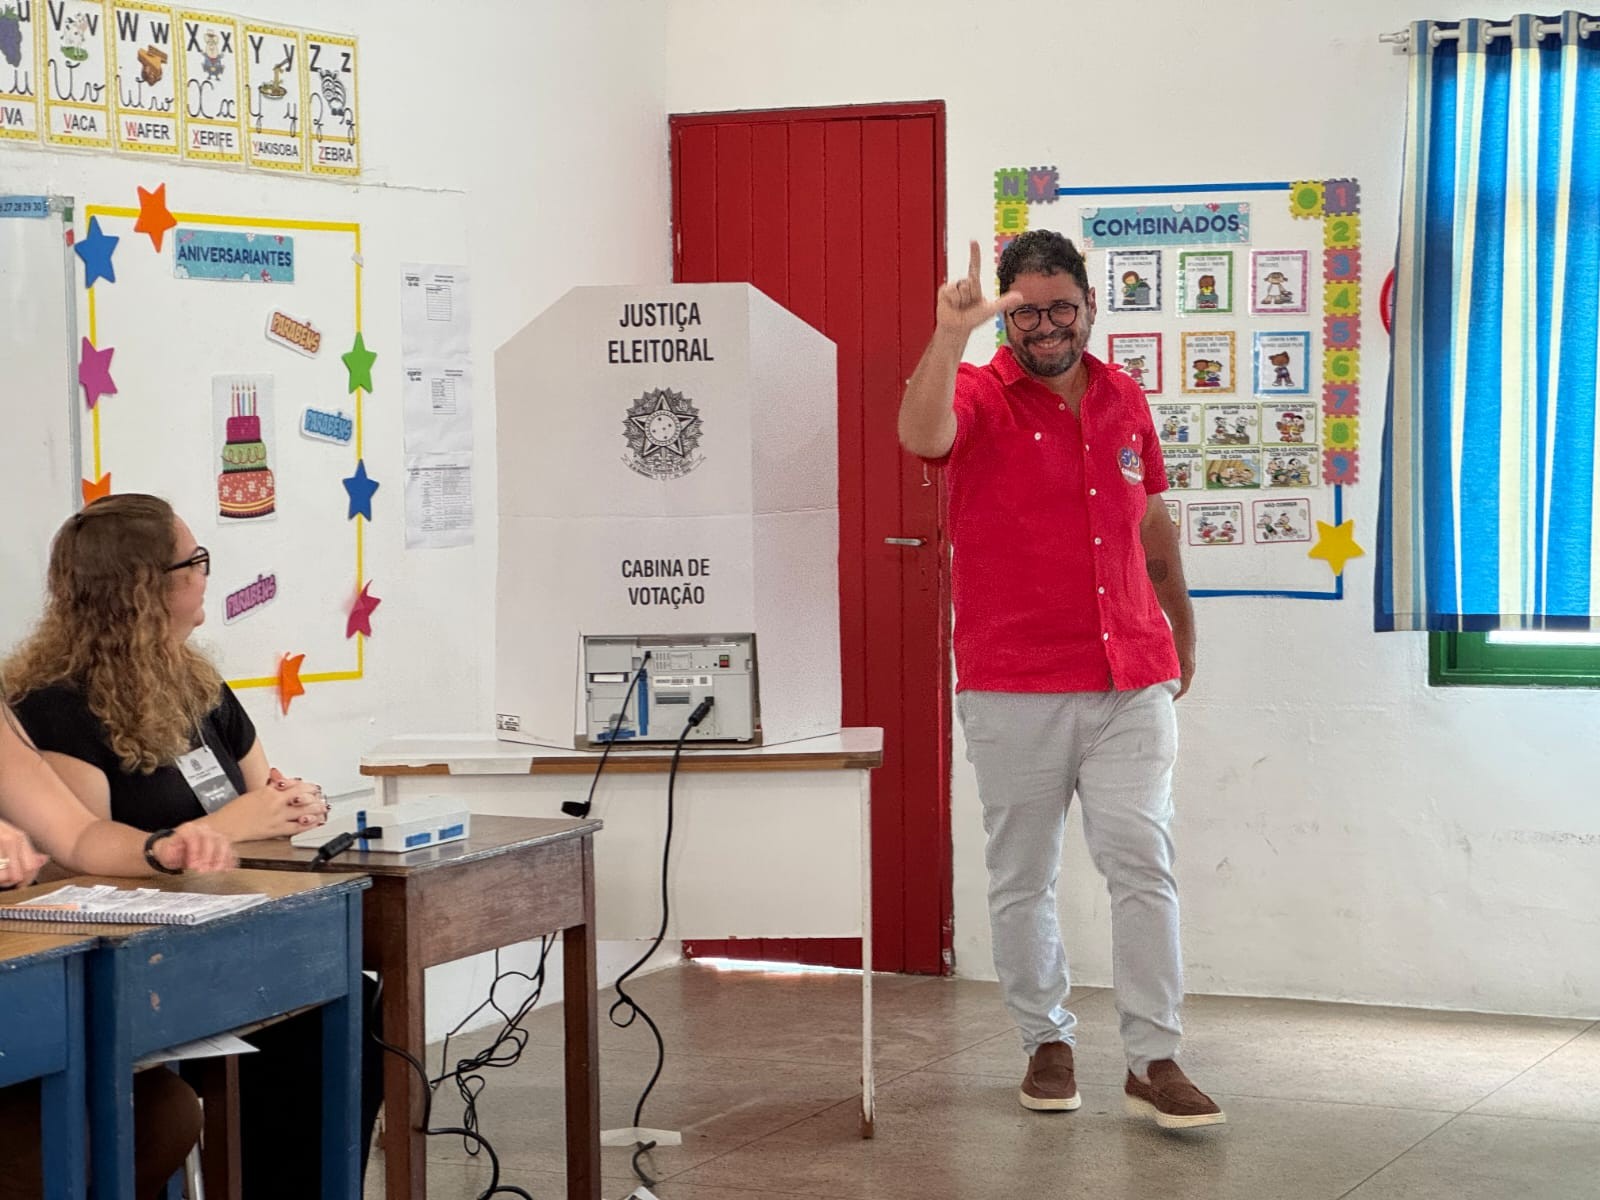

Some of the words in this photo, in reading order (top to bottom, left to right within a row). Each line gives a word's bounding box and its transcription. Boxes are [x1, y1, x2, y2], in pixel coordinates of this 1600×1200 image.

[48, 0, 65, 31] V
[85, 13, 99, 36] v
[116, 10, 139, 42] W
[185, 22, 202, 53] X
[248, 35, 263, 64] Y
[309, 44, 321, 73] Z
[63, 113, 97, 132] VACA
[125, 121, 170, 140] WAFER
[192, 129, 233, 147] XERIFE
[252, 141, 298, 156] YAKISOBA
[318, 146, 353, 163] ZEBRA
[1003, 175, 1020, 197] N
[1031, 175, 1050, 195] Y
[1335, 186, 1348, 207] 1
[1002, 208, 1020, 229] E
[1092, 214, 1240, 237] COMBINADOS
[1332, 220, 1350, 242] 2
[177, 245, 292, 267] ANIVERSARIANTES
[1332, 254, 1350, 276] 3
[1332, 287, 1351, 309] 4
[619, 302, 702, 332] JUSTIÇA
[1331, 321, 1350, 343] 5
[608, 338, 715, 363] ELEITORAL
[1331, 355, 1350, 377] 6
[1331, 389, 1349, 409] 7
[1331, 422, 1350, 444] 8
[1332, 455, 1349, 477] 9
[622, 559, 684, 578] CABINA
[688, 558, 710, 576] DE
[628, 582, 705, 609] VOTAÇÃO
